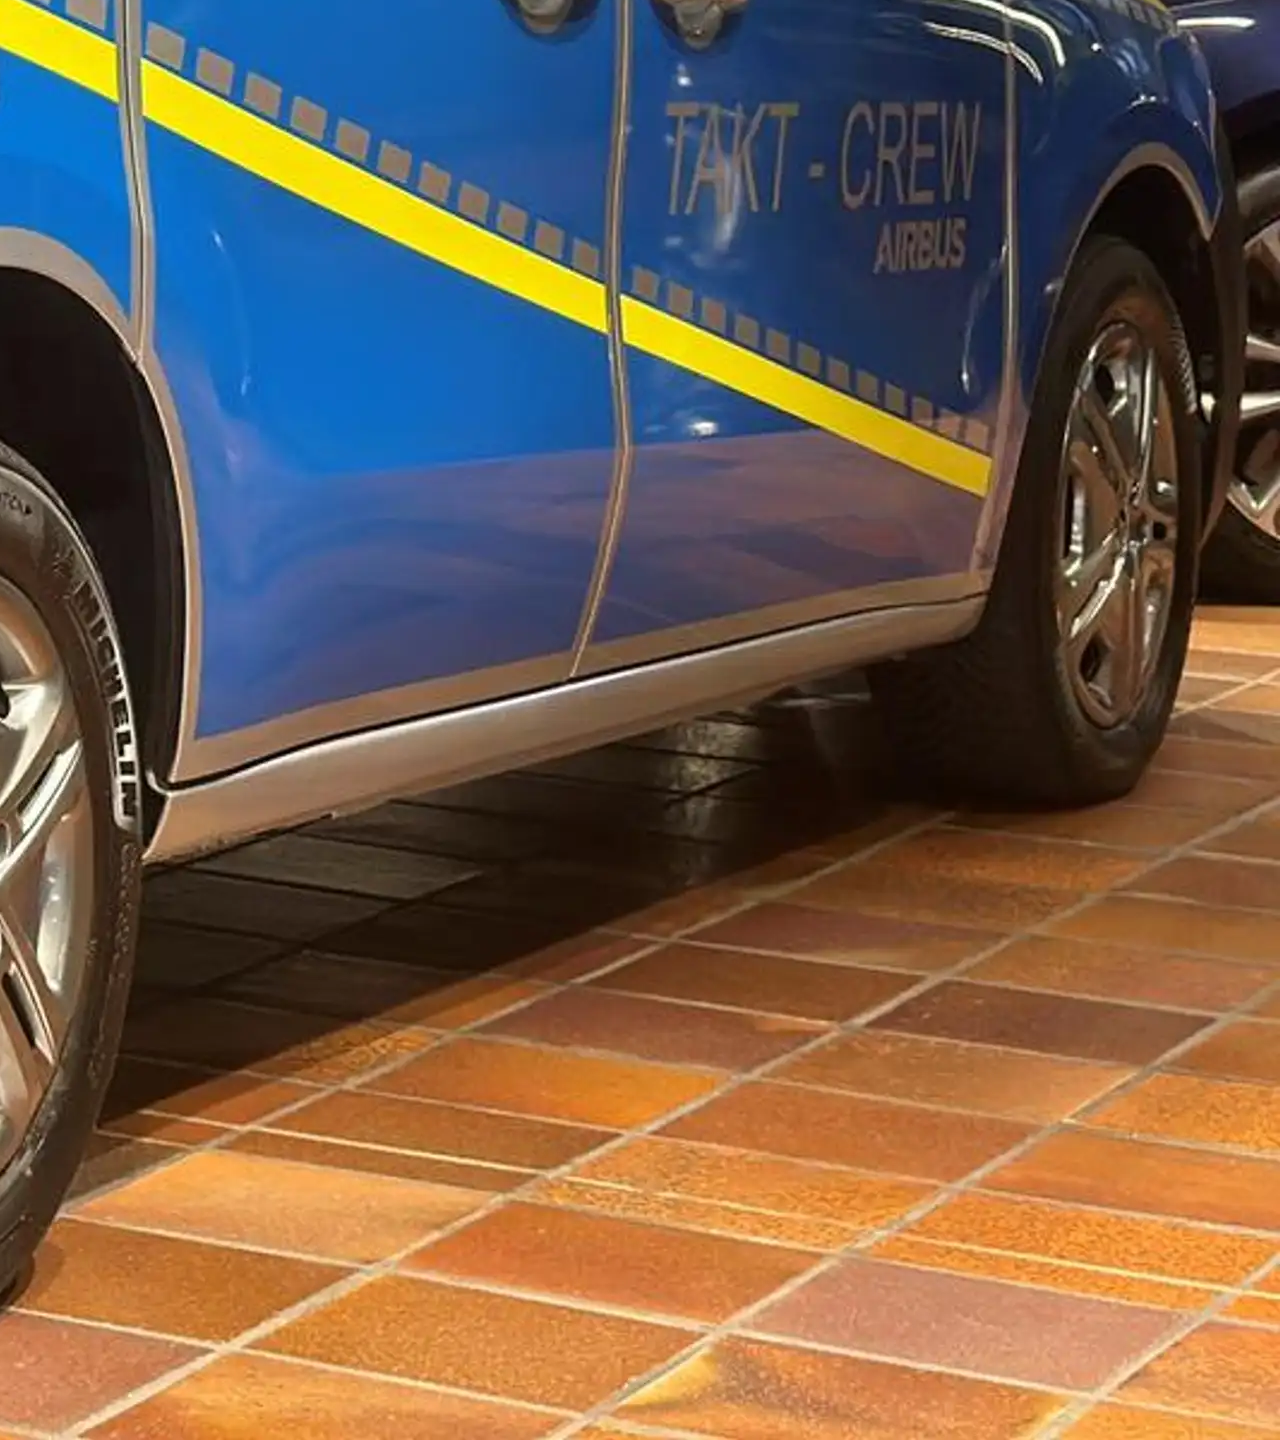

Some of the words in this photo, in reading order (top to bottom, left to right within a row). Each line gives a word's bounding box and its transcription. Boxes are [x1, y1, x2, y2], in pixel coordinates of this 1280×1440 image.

[666, 102, 800, 215] TAKT
[842, 101, 981, 209] CREW
[873, 217, 967, 274] AIRBUS
[72, 578, 138, 818] MICHELIN
